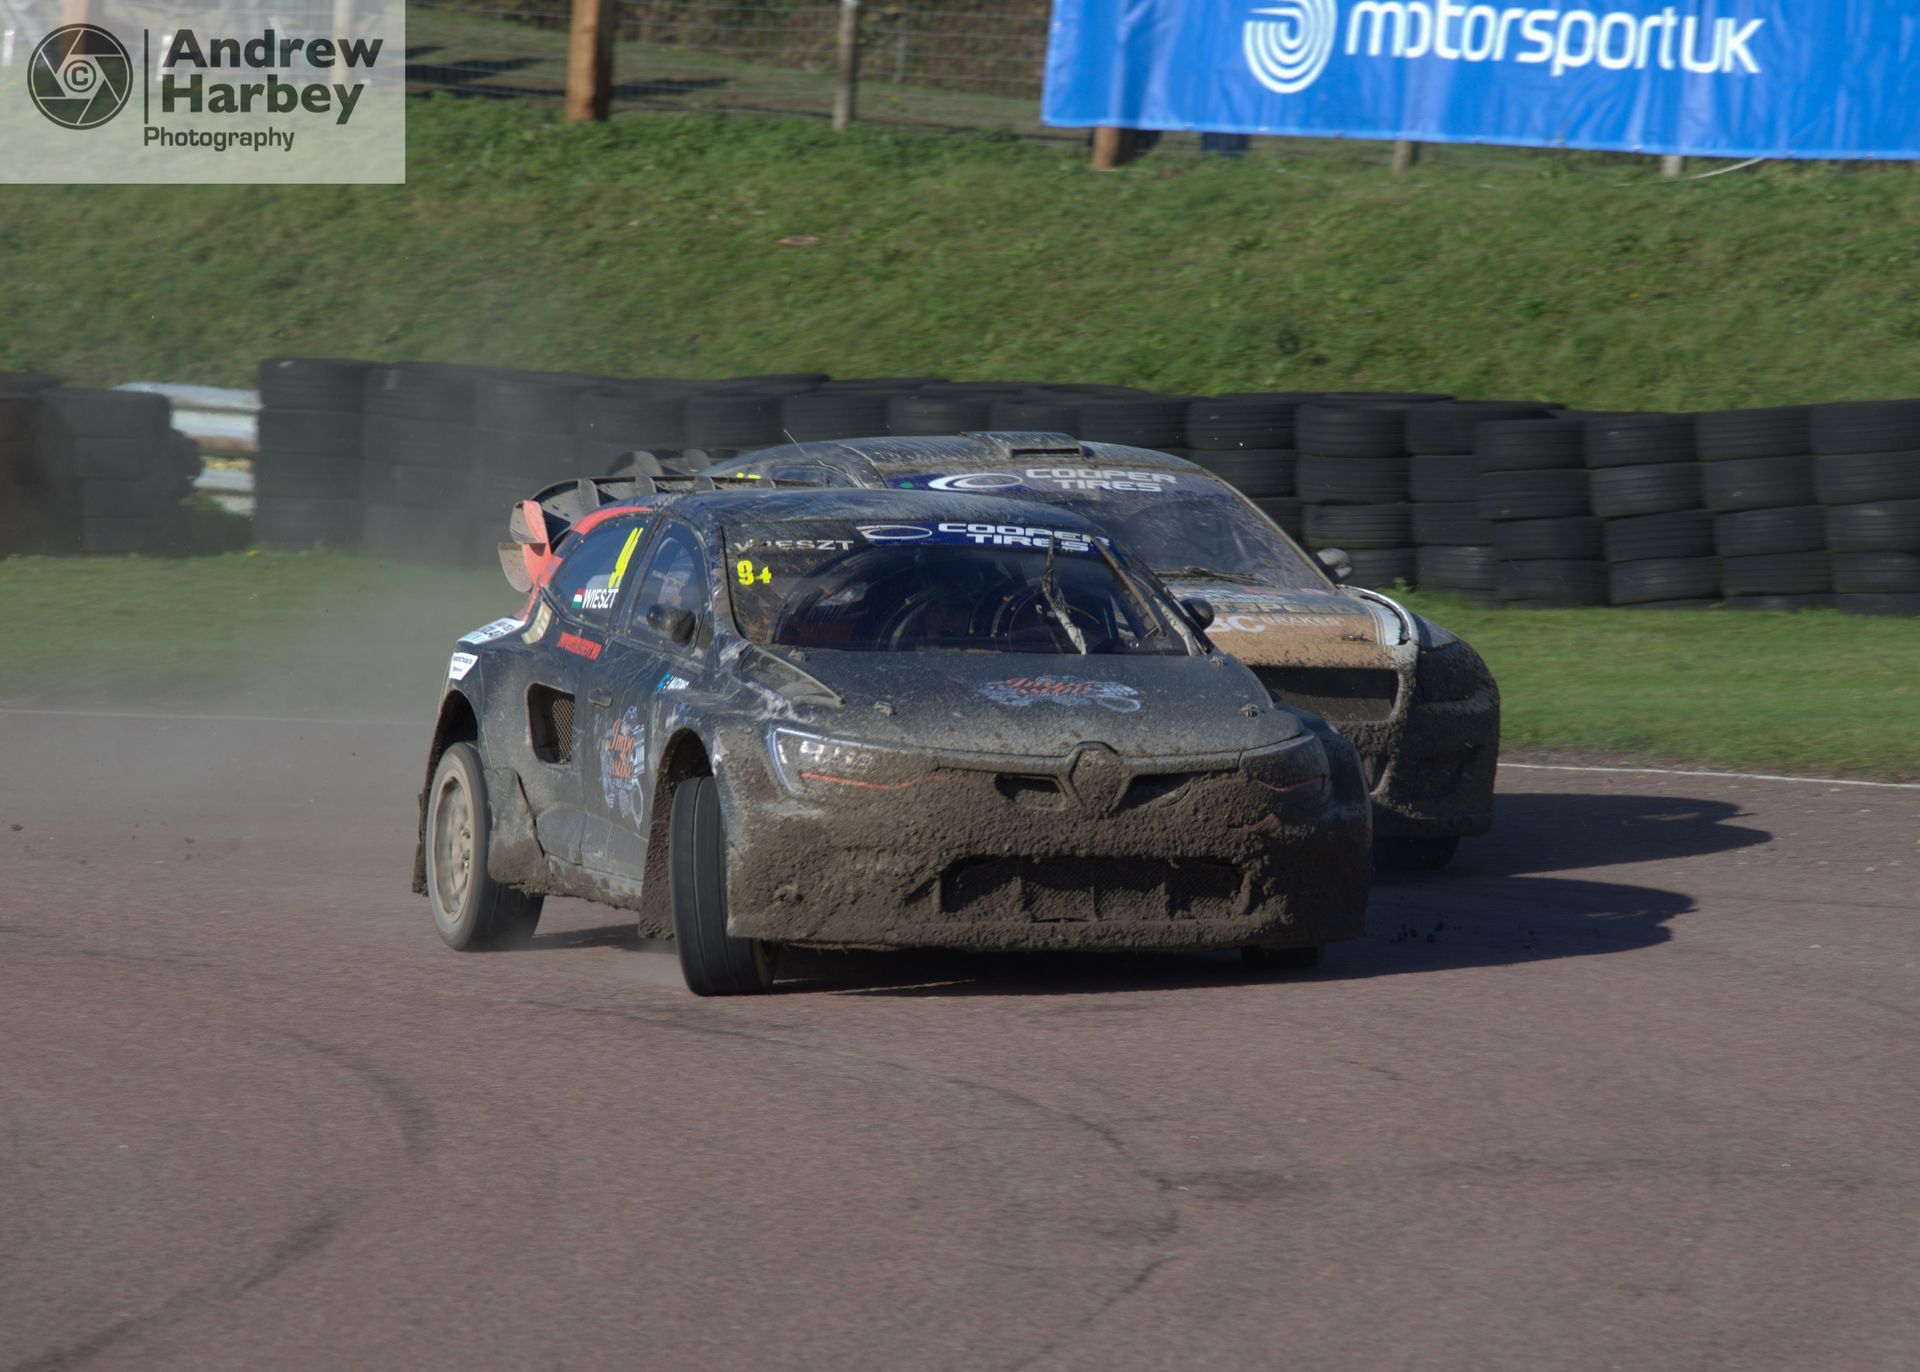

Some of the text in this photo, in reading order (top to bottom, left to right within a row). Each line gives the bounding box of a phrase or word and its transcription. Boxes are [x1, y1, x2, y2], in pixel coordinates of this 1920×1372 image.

[1025, 469, 1178, 484] COOPER
[1053, 479, 1162, 493] TIRES
[938, 522, 1110, 547] COOPER
[966, 533, 1089, 552] TIRES
[582, 588, 619, 609] WIESZT
